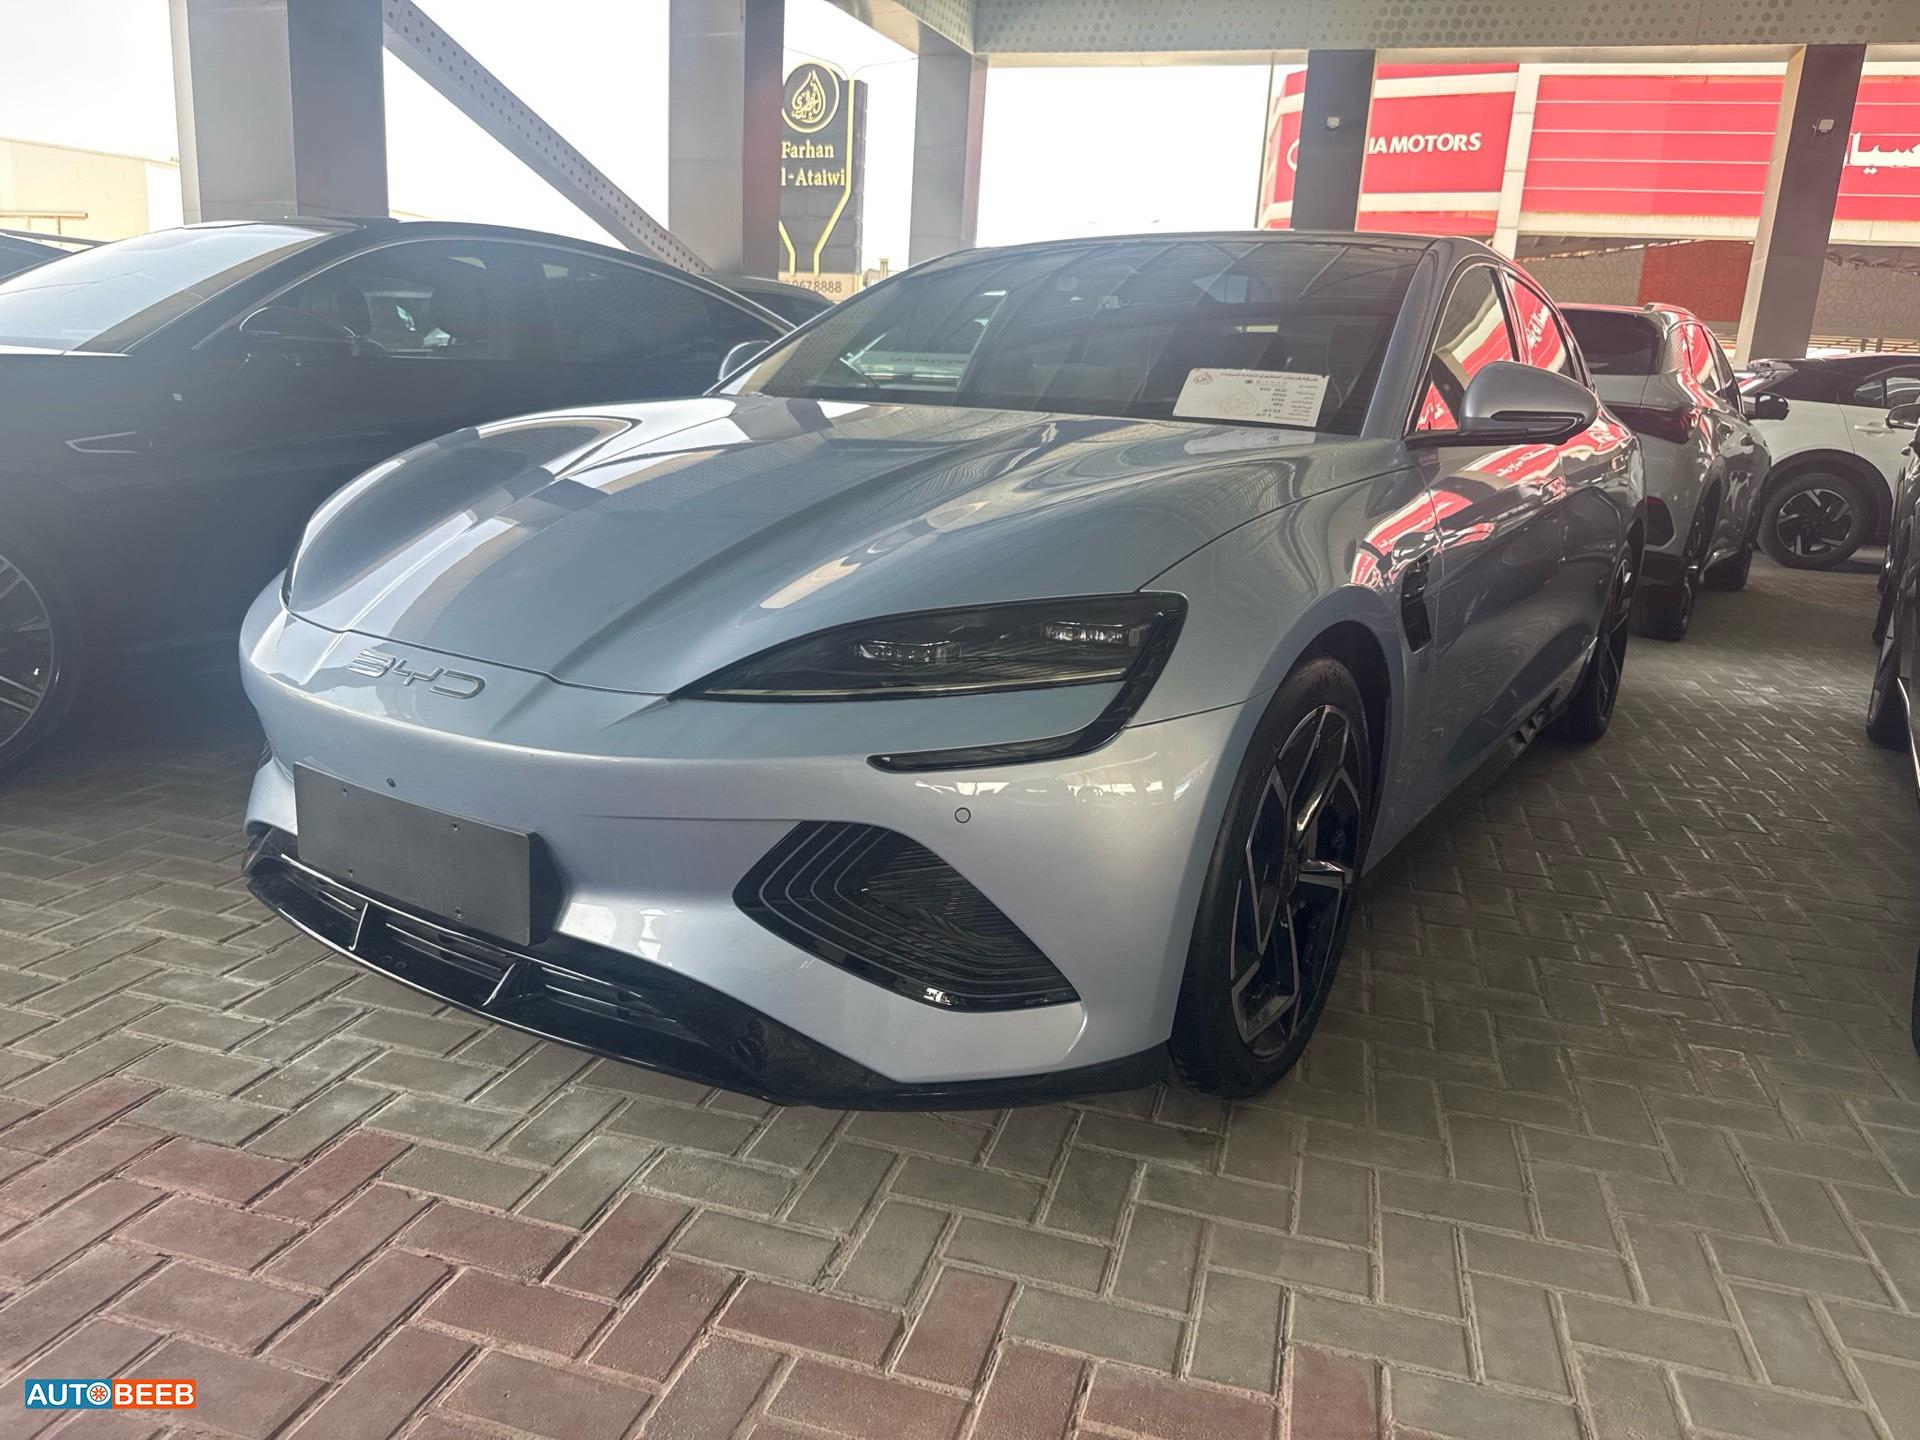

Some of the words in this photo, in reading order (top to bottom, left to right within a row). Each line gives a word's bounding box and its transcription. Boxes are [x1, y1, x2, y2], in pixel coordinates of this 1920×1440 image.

[781, 139, 834, 159] Farhan
[1367, 137, 1388, 154] IA
[1389, 132, 1482, 154] MOTORS
[781, 167, 846, 187] l-Ataiwi
[347, 649, 486, 700] BYD
